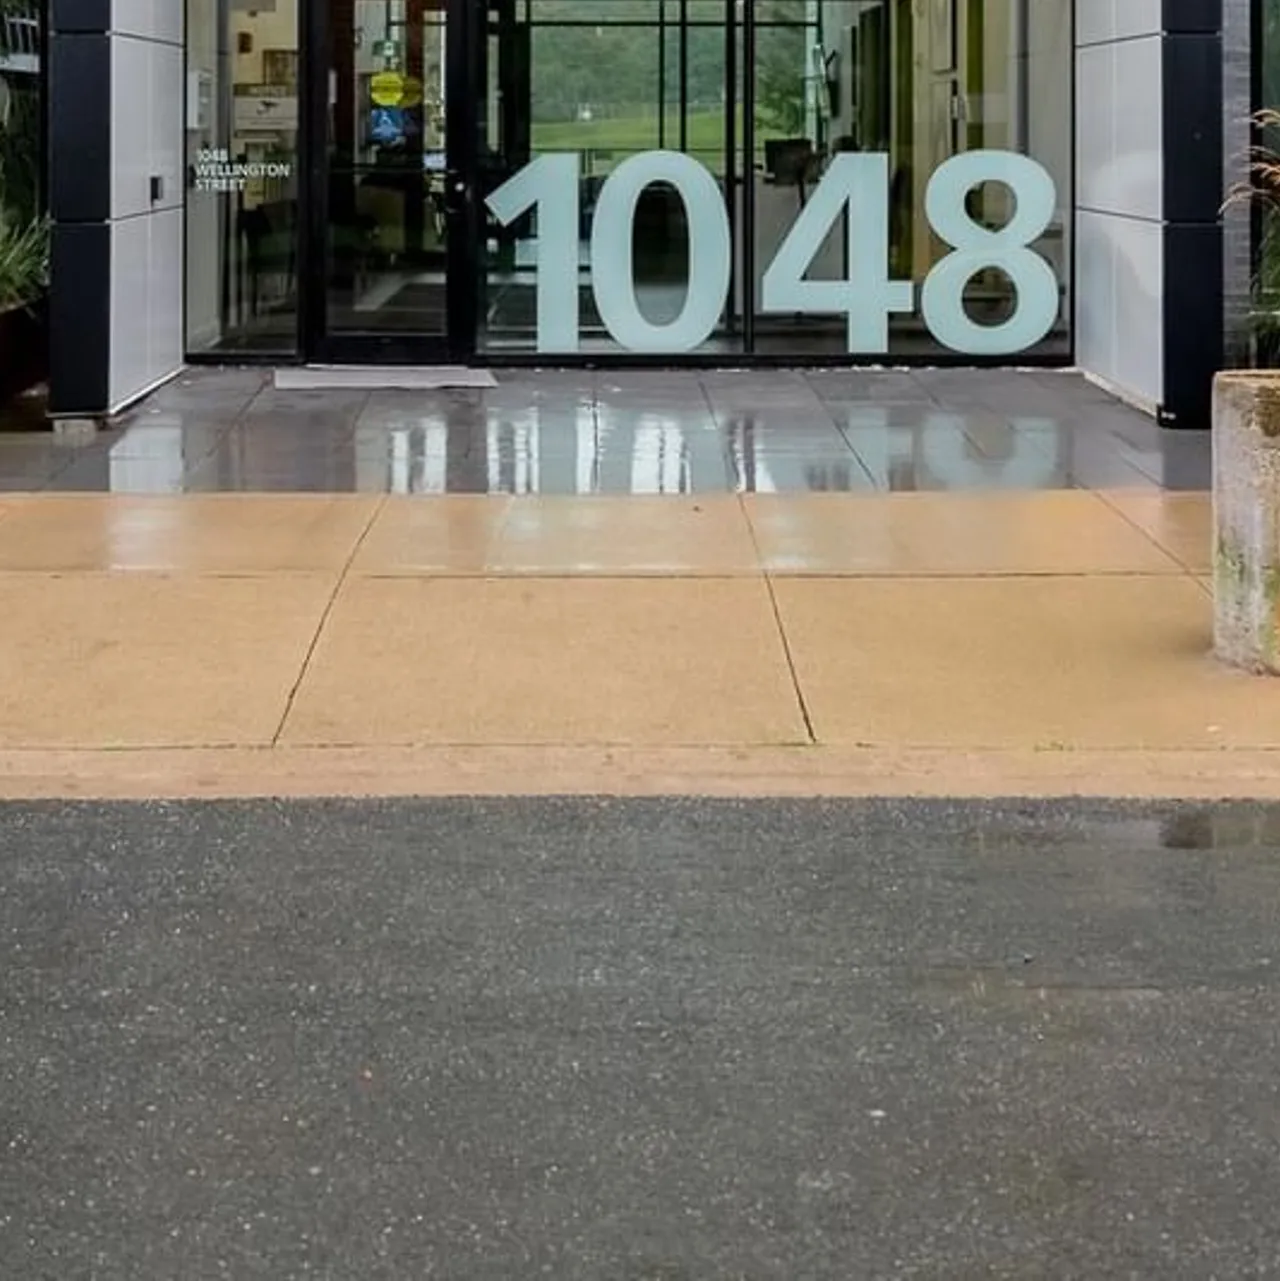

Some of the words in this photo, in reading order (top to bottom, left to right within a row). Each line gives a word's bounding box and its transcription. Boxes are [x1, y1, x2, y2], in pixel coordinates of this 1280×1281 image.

[195, 163, 291, 177] WELLINGTON
[195, 177, 245, 192] STREET
[484, 149, 1060, 356] 1048
